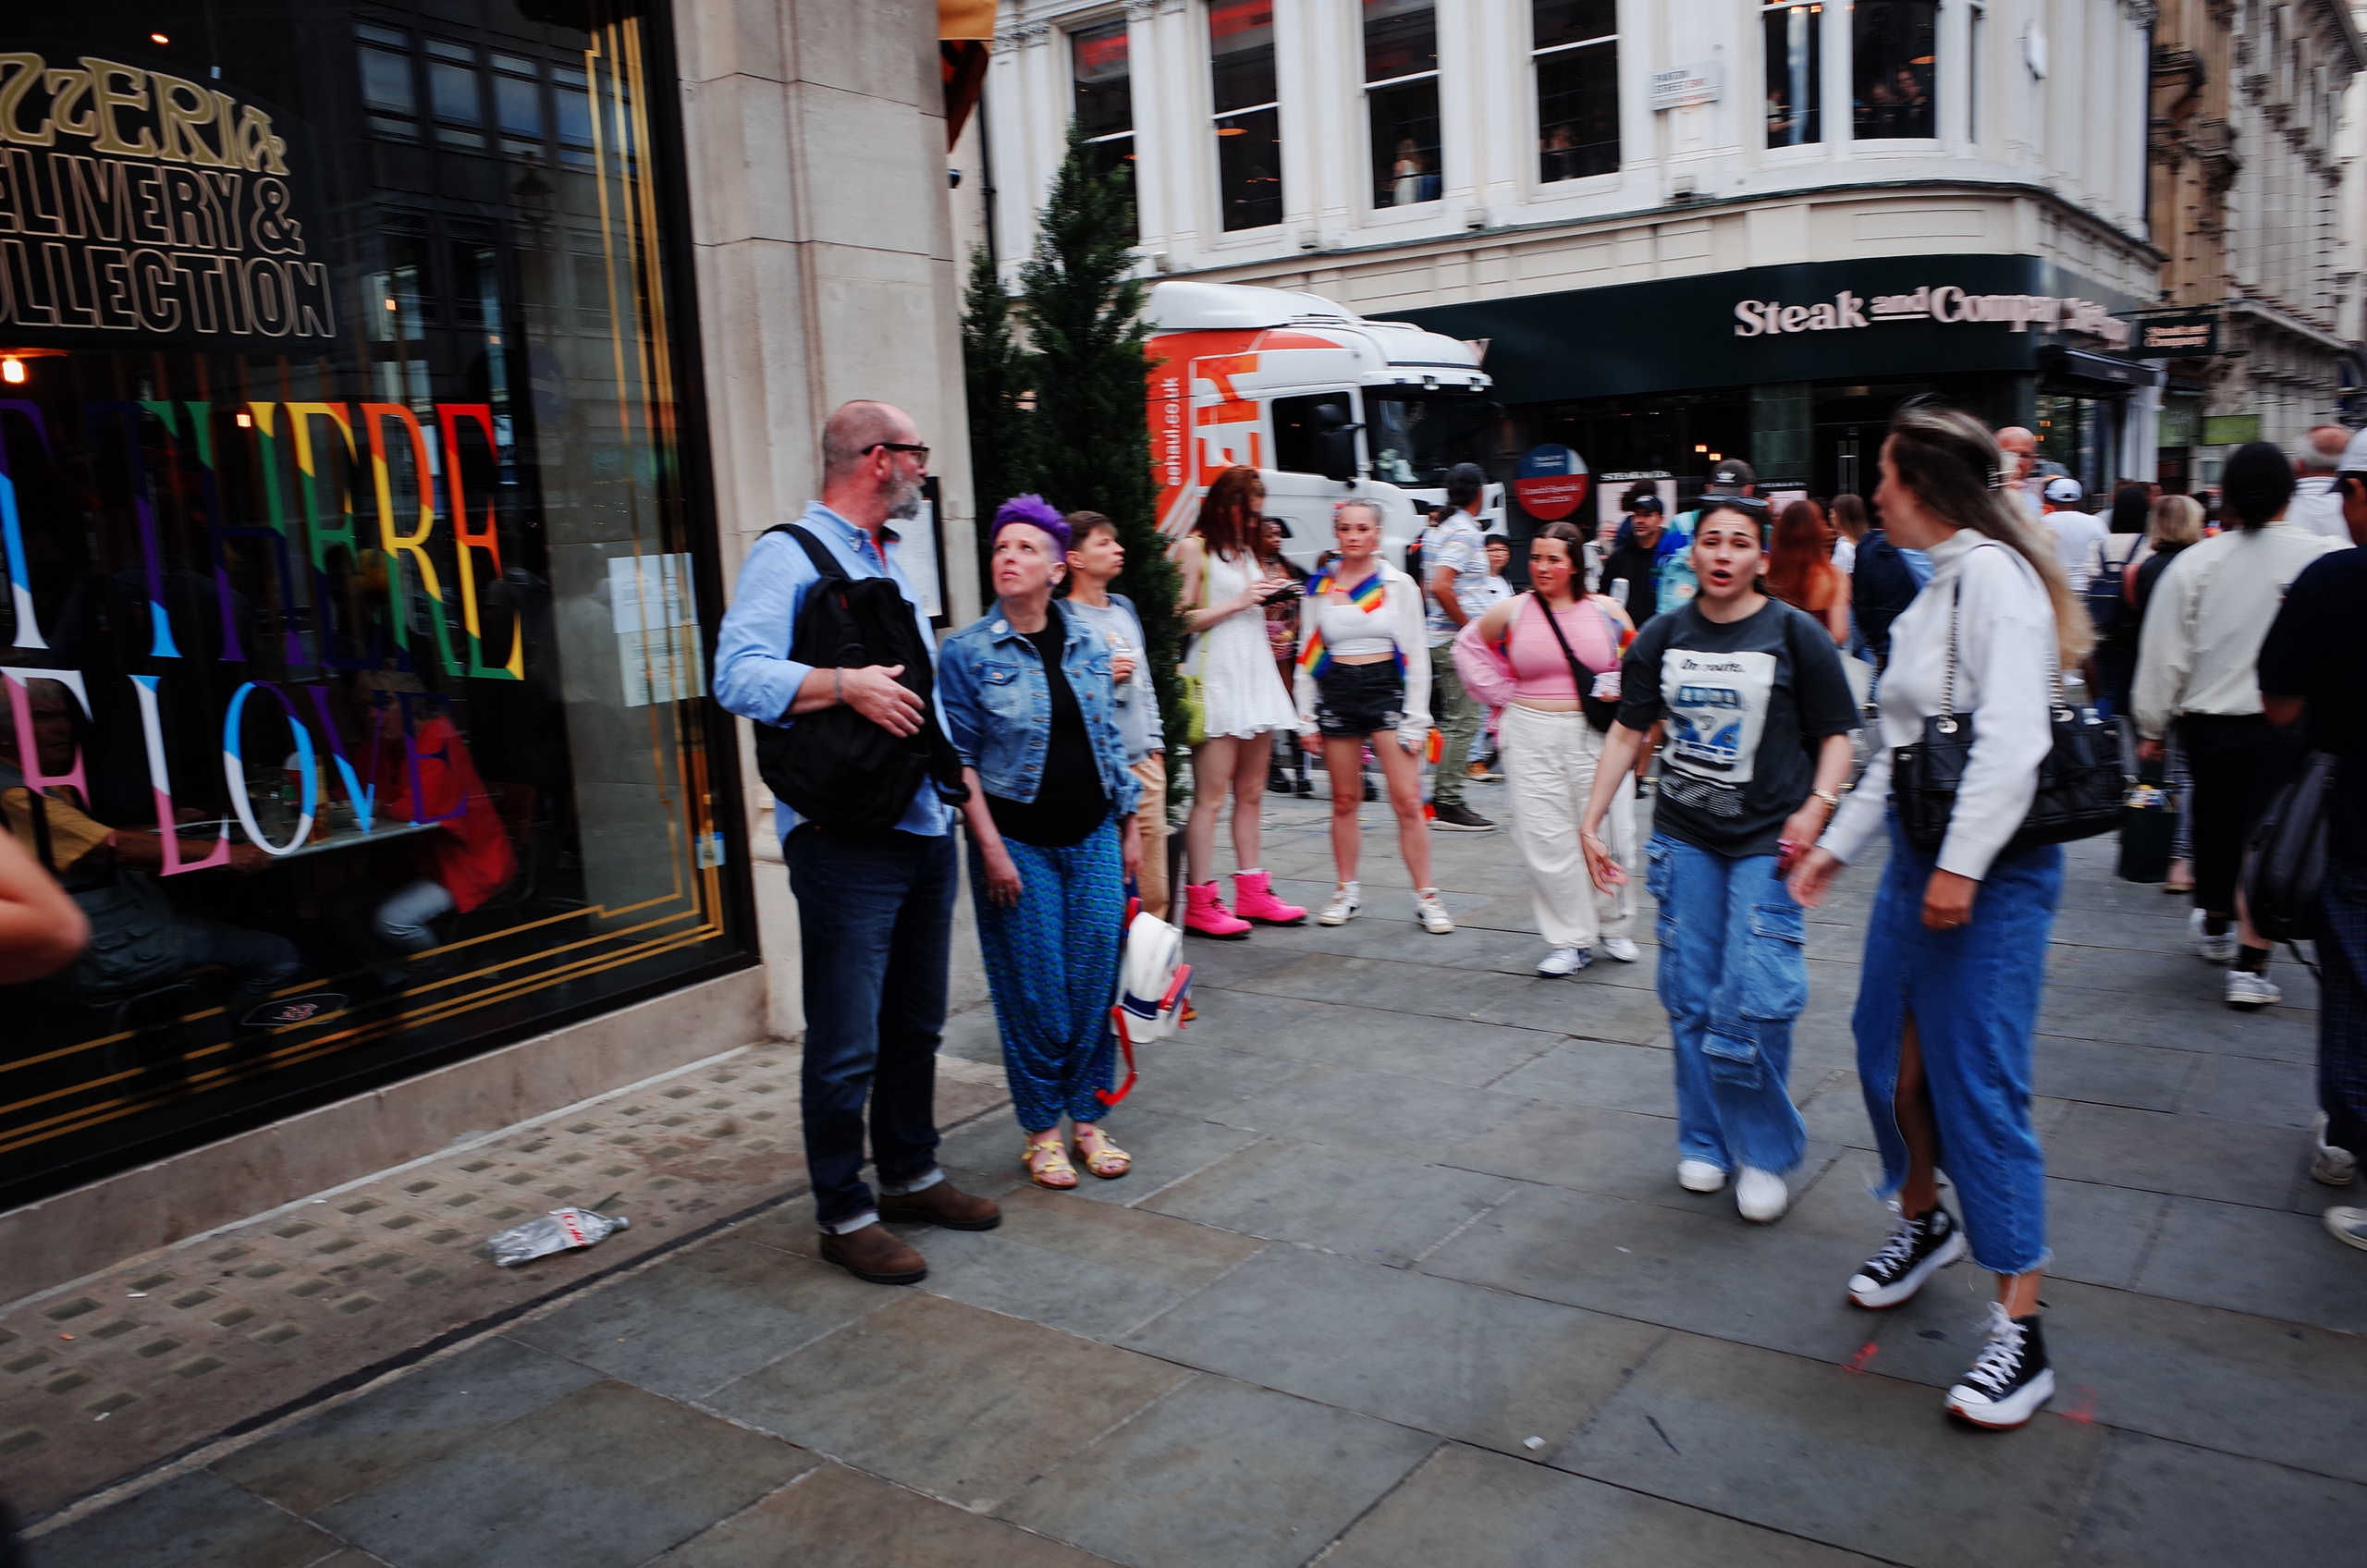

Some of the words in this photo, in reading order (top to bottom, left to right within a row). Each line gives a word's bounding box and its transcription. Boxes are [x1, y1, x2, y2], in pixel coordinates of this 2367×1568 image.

[251, 177, 305, 255] &
[0, 239, 336, 337] LLECTION
[1734, 289, 1870, 337] Steak
[1870, 286, 1931, 315] and
[85, 400, 526, 680] THERE
[128, 674, 469, 876] LOVE
